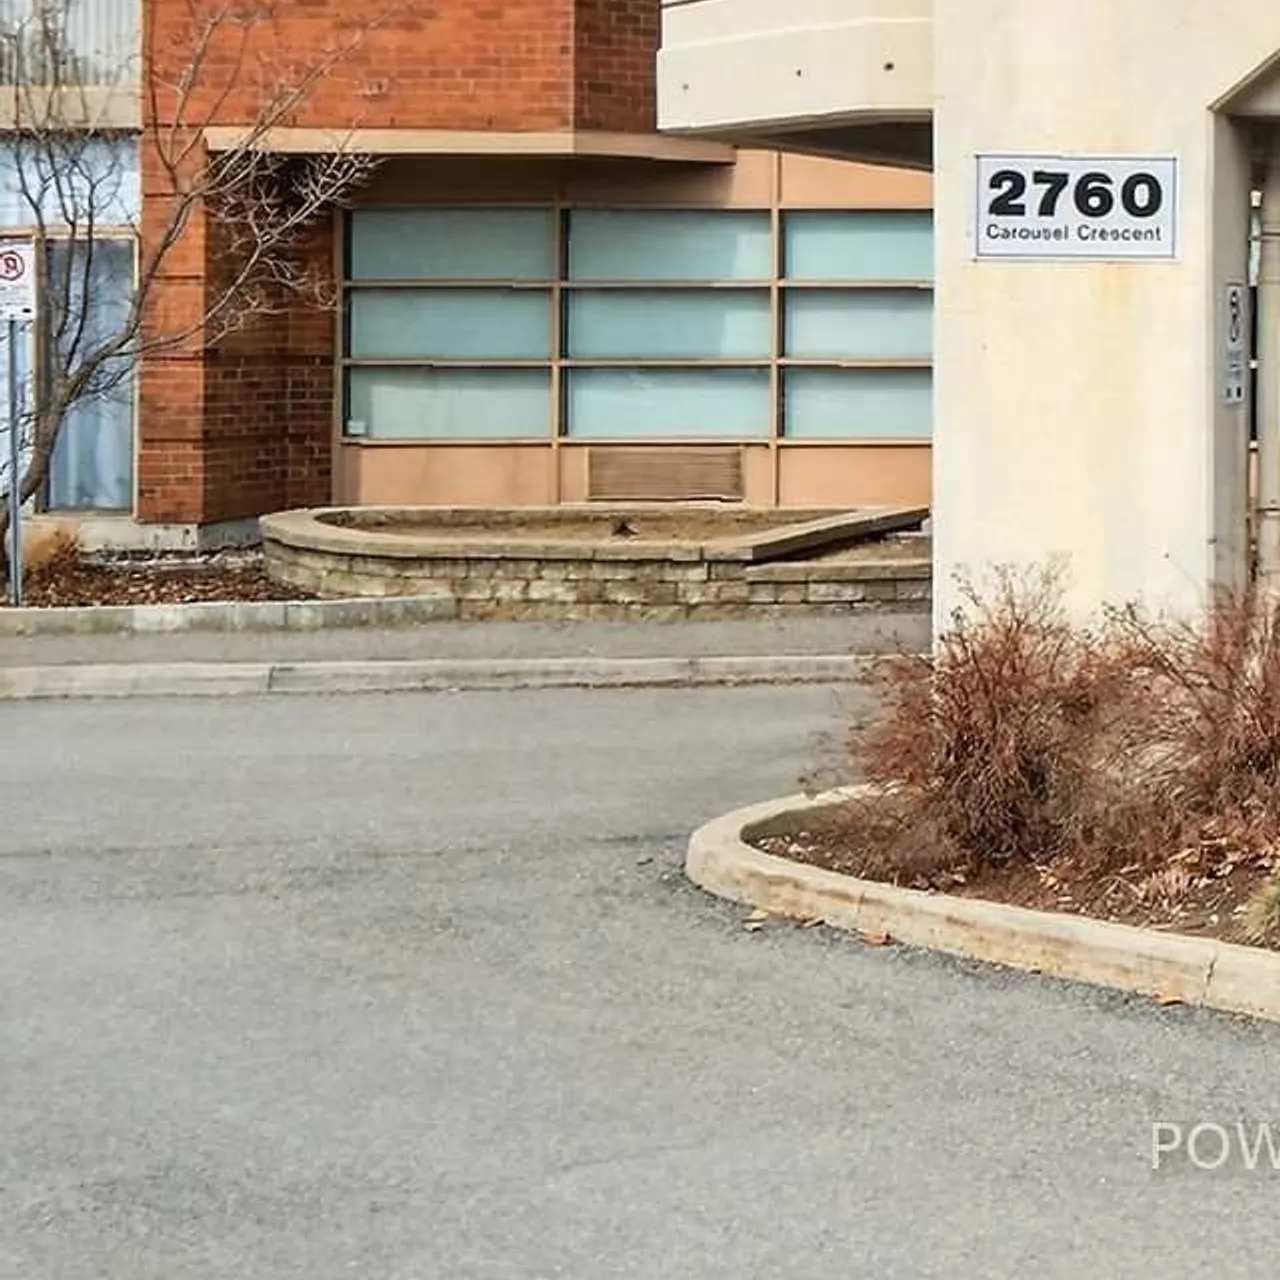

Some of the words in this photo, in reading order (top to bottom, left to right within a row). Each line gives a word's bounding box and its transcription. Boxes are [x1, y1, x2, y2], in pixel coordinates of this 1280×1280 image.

[987, 169, 1163, 218] 2760
[985, 223, 1069, 241] Carousel
[1076, 223, 1162, 241] Crescent
